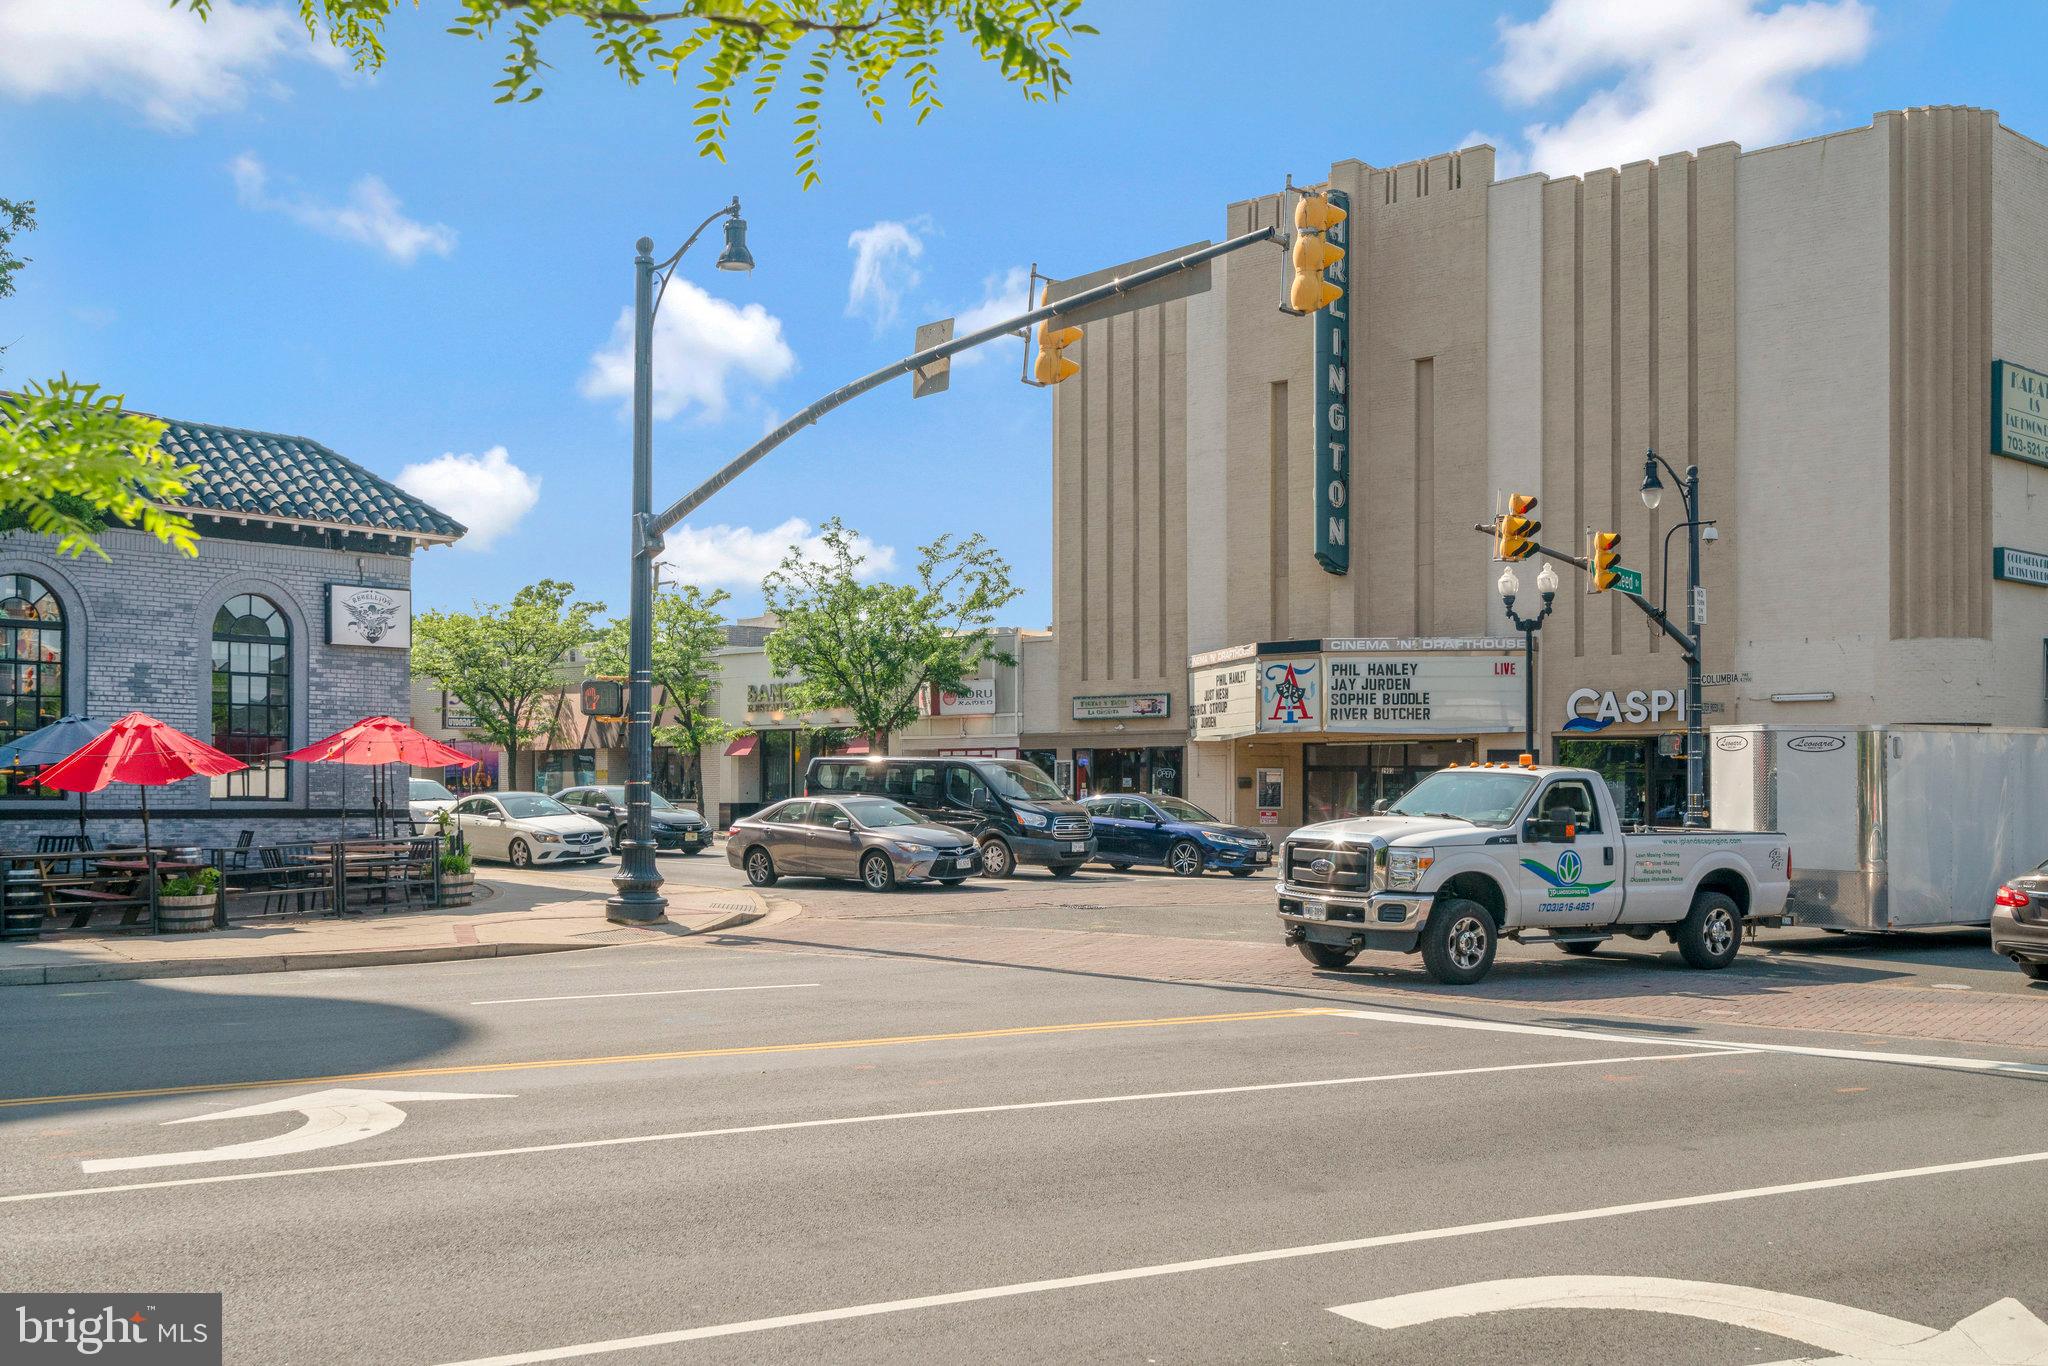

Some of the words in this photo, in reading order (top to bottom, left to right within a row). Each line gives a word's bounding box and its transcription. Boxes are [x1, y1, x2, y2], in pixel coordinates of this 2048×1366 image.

[352, 594, 391, 606] REBELLION
[1331, 640, 1389, 650] CINEMA
[1423, 639, 1526, 650] DRAFTHOUSE
[1331, 664, 1360, 676] PHIL
[1368, 663, 1418, 676] HANLEY
[1494, 662, 1516, 675] LIVE
[1216, 674, 1227, 687] PHIL
[1229, 670, 1247, 685] HANLEY
[1331, 679, 1356, 691] JAY
[1362, 678, 1411, 691] JURDEN
[1701, 674, 1738, 684] COLUMBIA
[1204, 688, 1215, 702] JUST
[1331, 693, 1376, 705] SOPHIE
[1383, 693, 1430, 705] BUDDLE
[1566, 687, 1686, 724] CASPI
[1330, 708, 1368, 720] RIVER
[1373, 707, 1431, 720] BUTCHER
[1201, 716, 1217, 729] JURDEN
[1795, 739, 1835, 747] Leonard
[1157, 768, 1176, 779] OPEN
[1538, 902, 1595, 912] (703)216-4851
